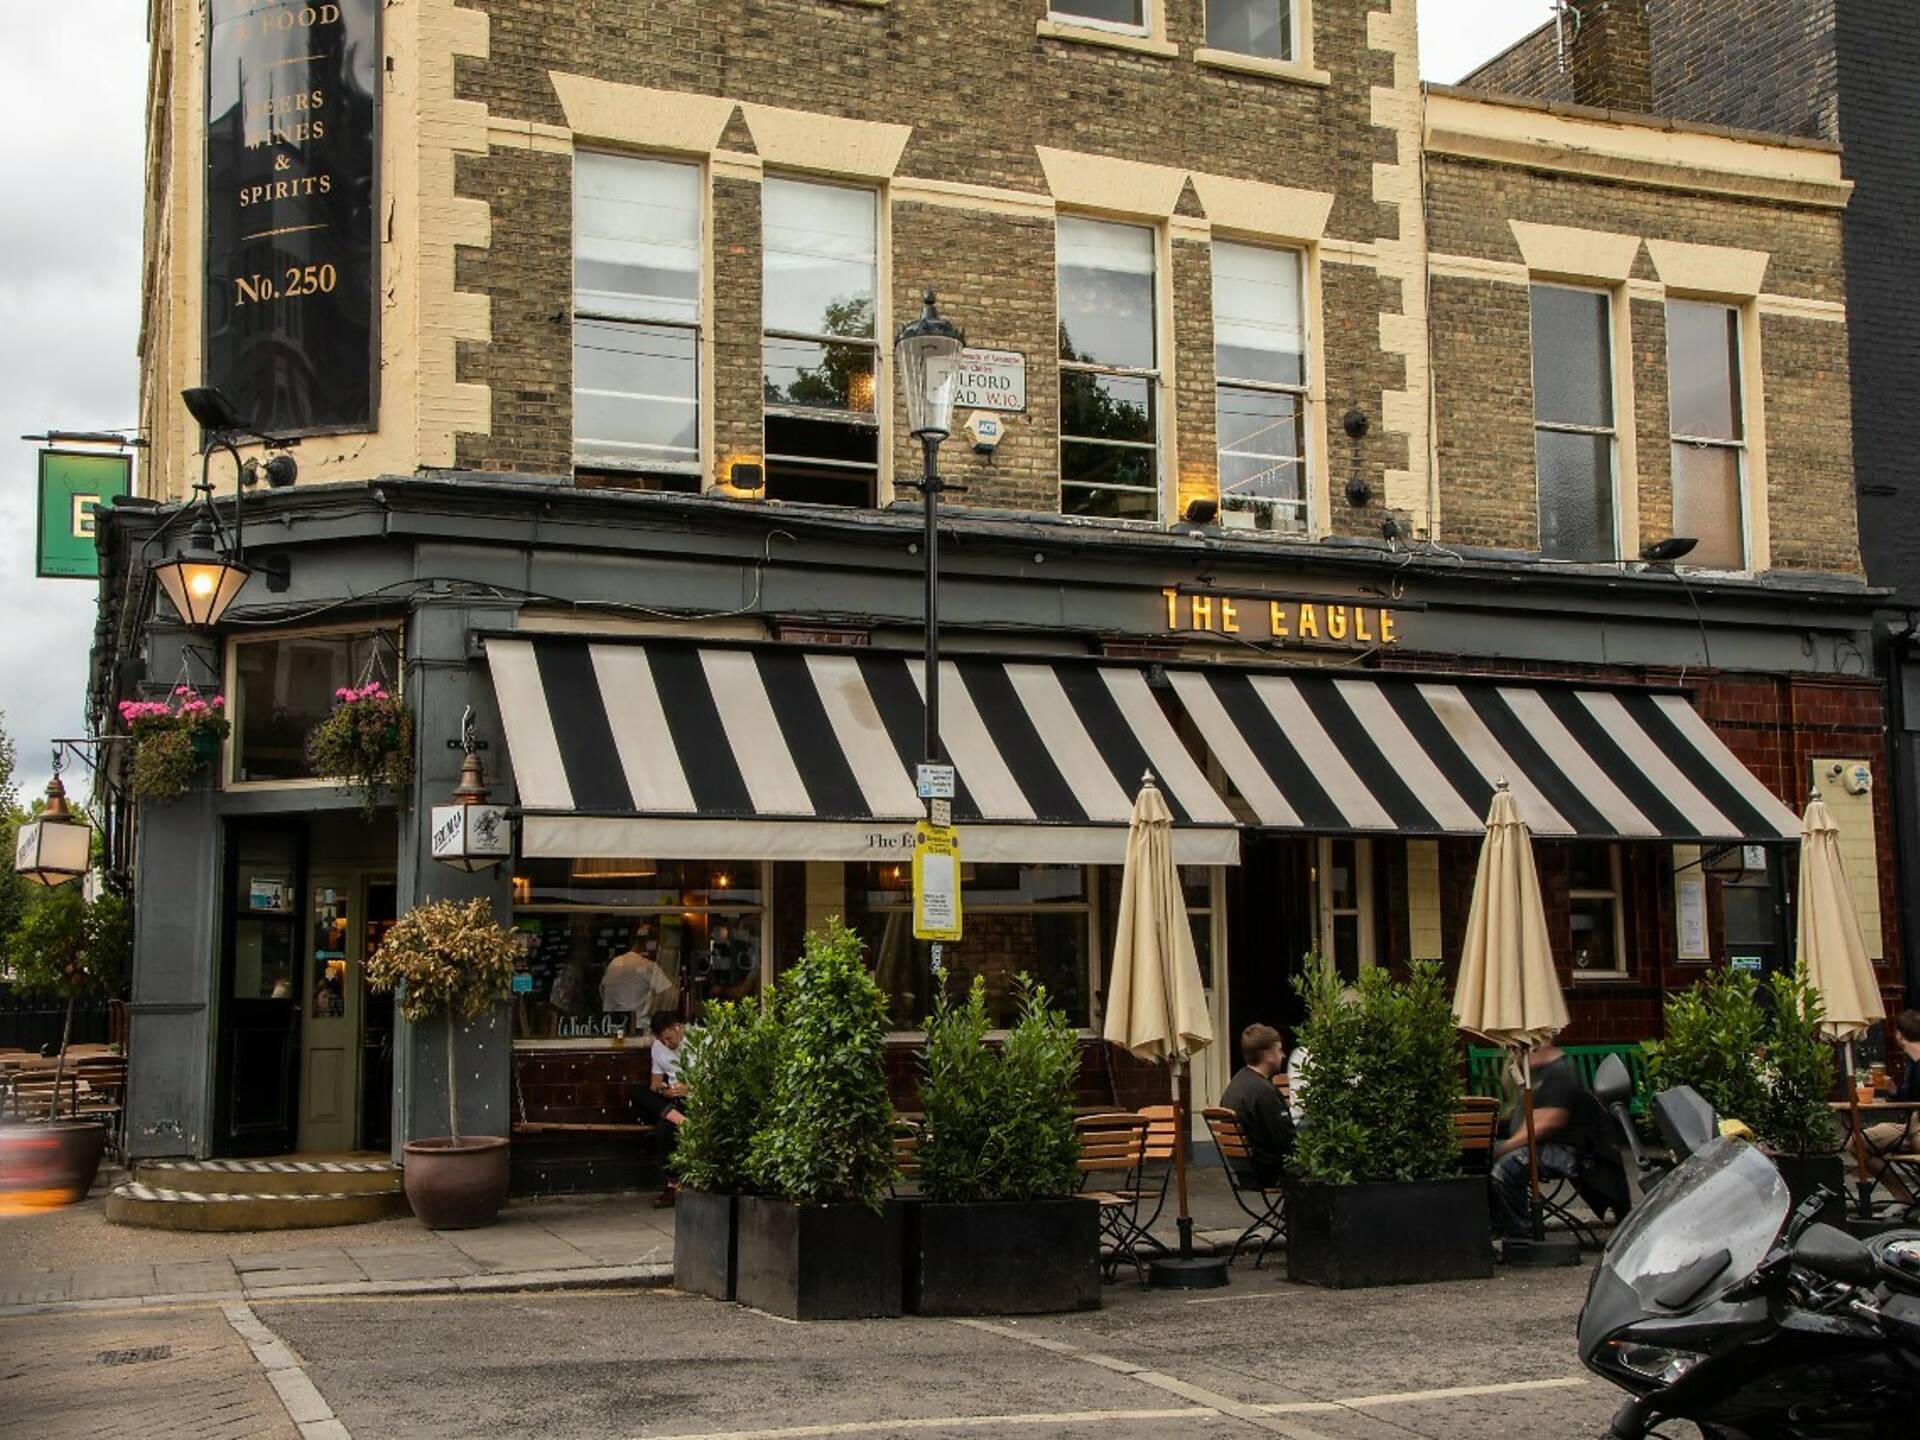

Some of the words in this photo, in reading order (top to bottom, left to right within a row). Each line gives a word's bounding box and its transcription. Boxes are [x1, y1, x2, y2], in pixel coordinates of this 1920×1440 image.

[248, 90, 324, 118] EERS
[274, 154, 291, 171] &
[240, 174, 332, 208] SPIRITS
[284, 264, 336, 297] 250
[1162, 587, 1240, 632] THE
[1270, 600, 1398, 643] EAGLE
[865, 833, 897, 849] The
